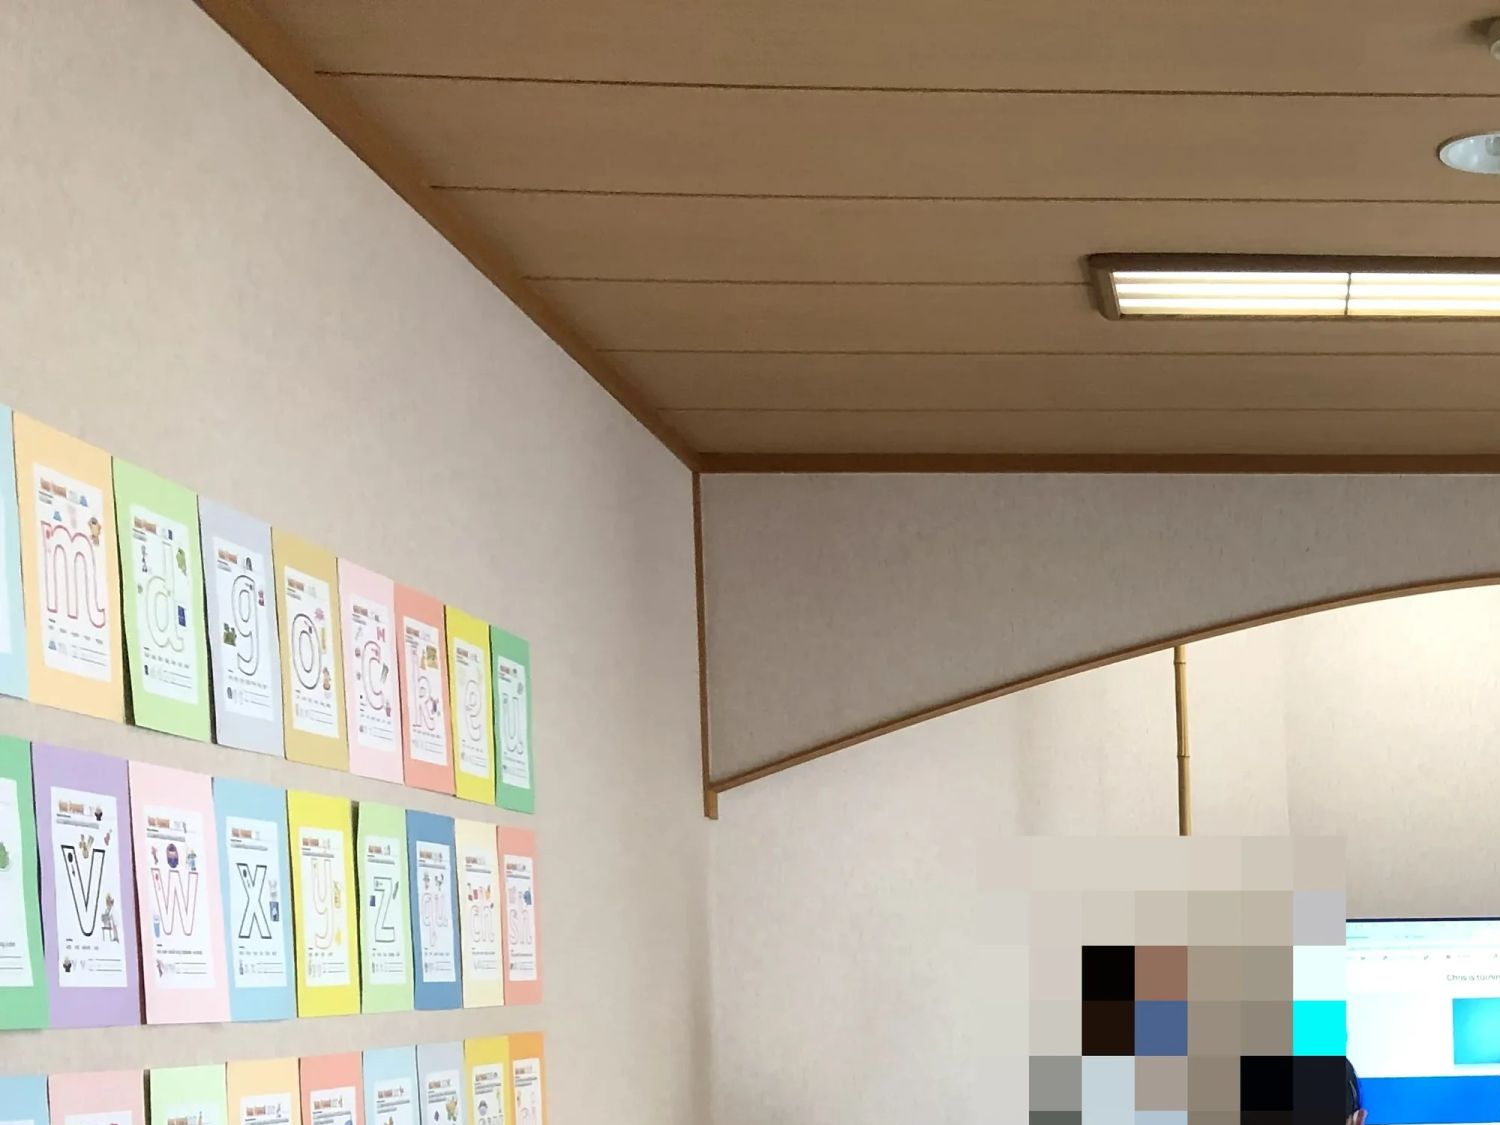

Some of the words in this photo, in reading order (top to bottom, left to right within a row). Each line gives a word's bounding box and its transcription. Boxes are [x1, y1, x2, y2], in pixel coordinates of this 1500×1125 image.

[41, 520, 106, 628] m
[146, 541, 184, 652] d
[231, 574, 259, 676] g
[291, 613, 322, 690] o
[362, 640, 385, 711] c
[61, 845, 105, 937] v
[151, 868, 198, 936] w
[236, 862, 273, 940] x
[311, 858, 334, 949] y
[374, 877, 396, 943] z
[1446, 973, 1467, 981] Chris
